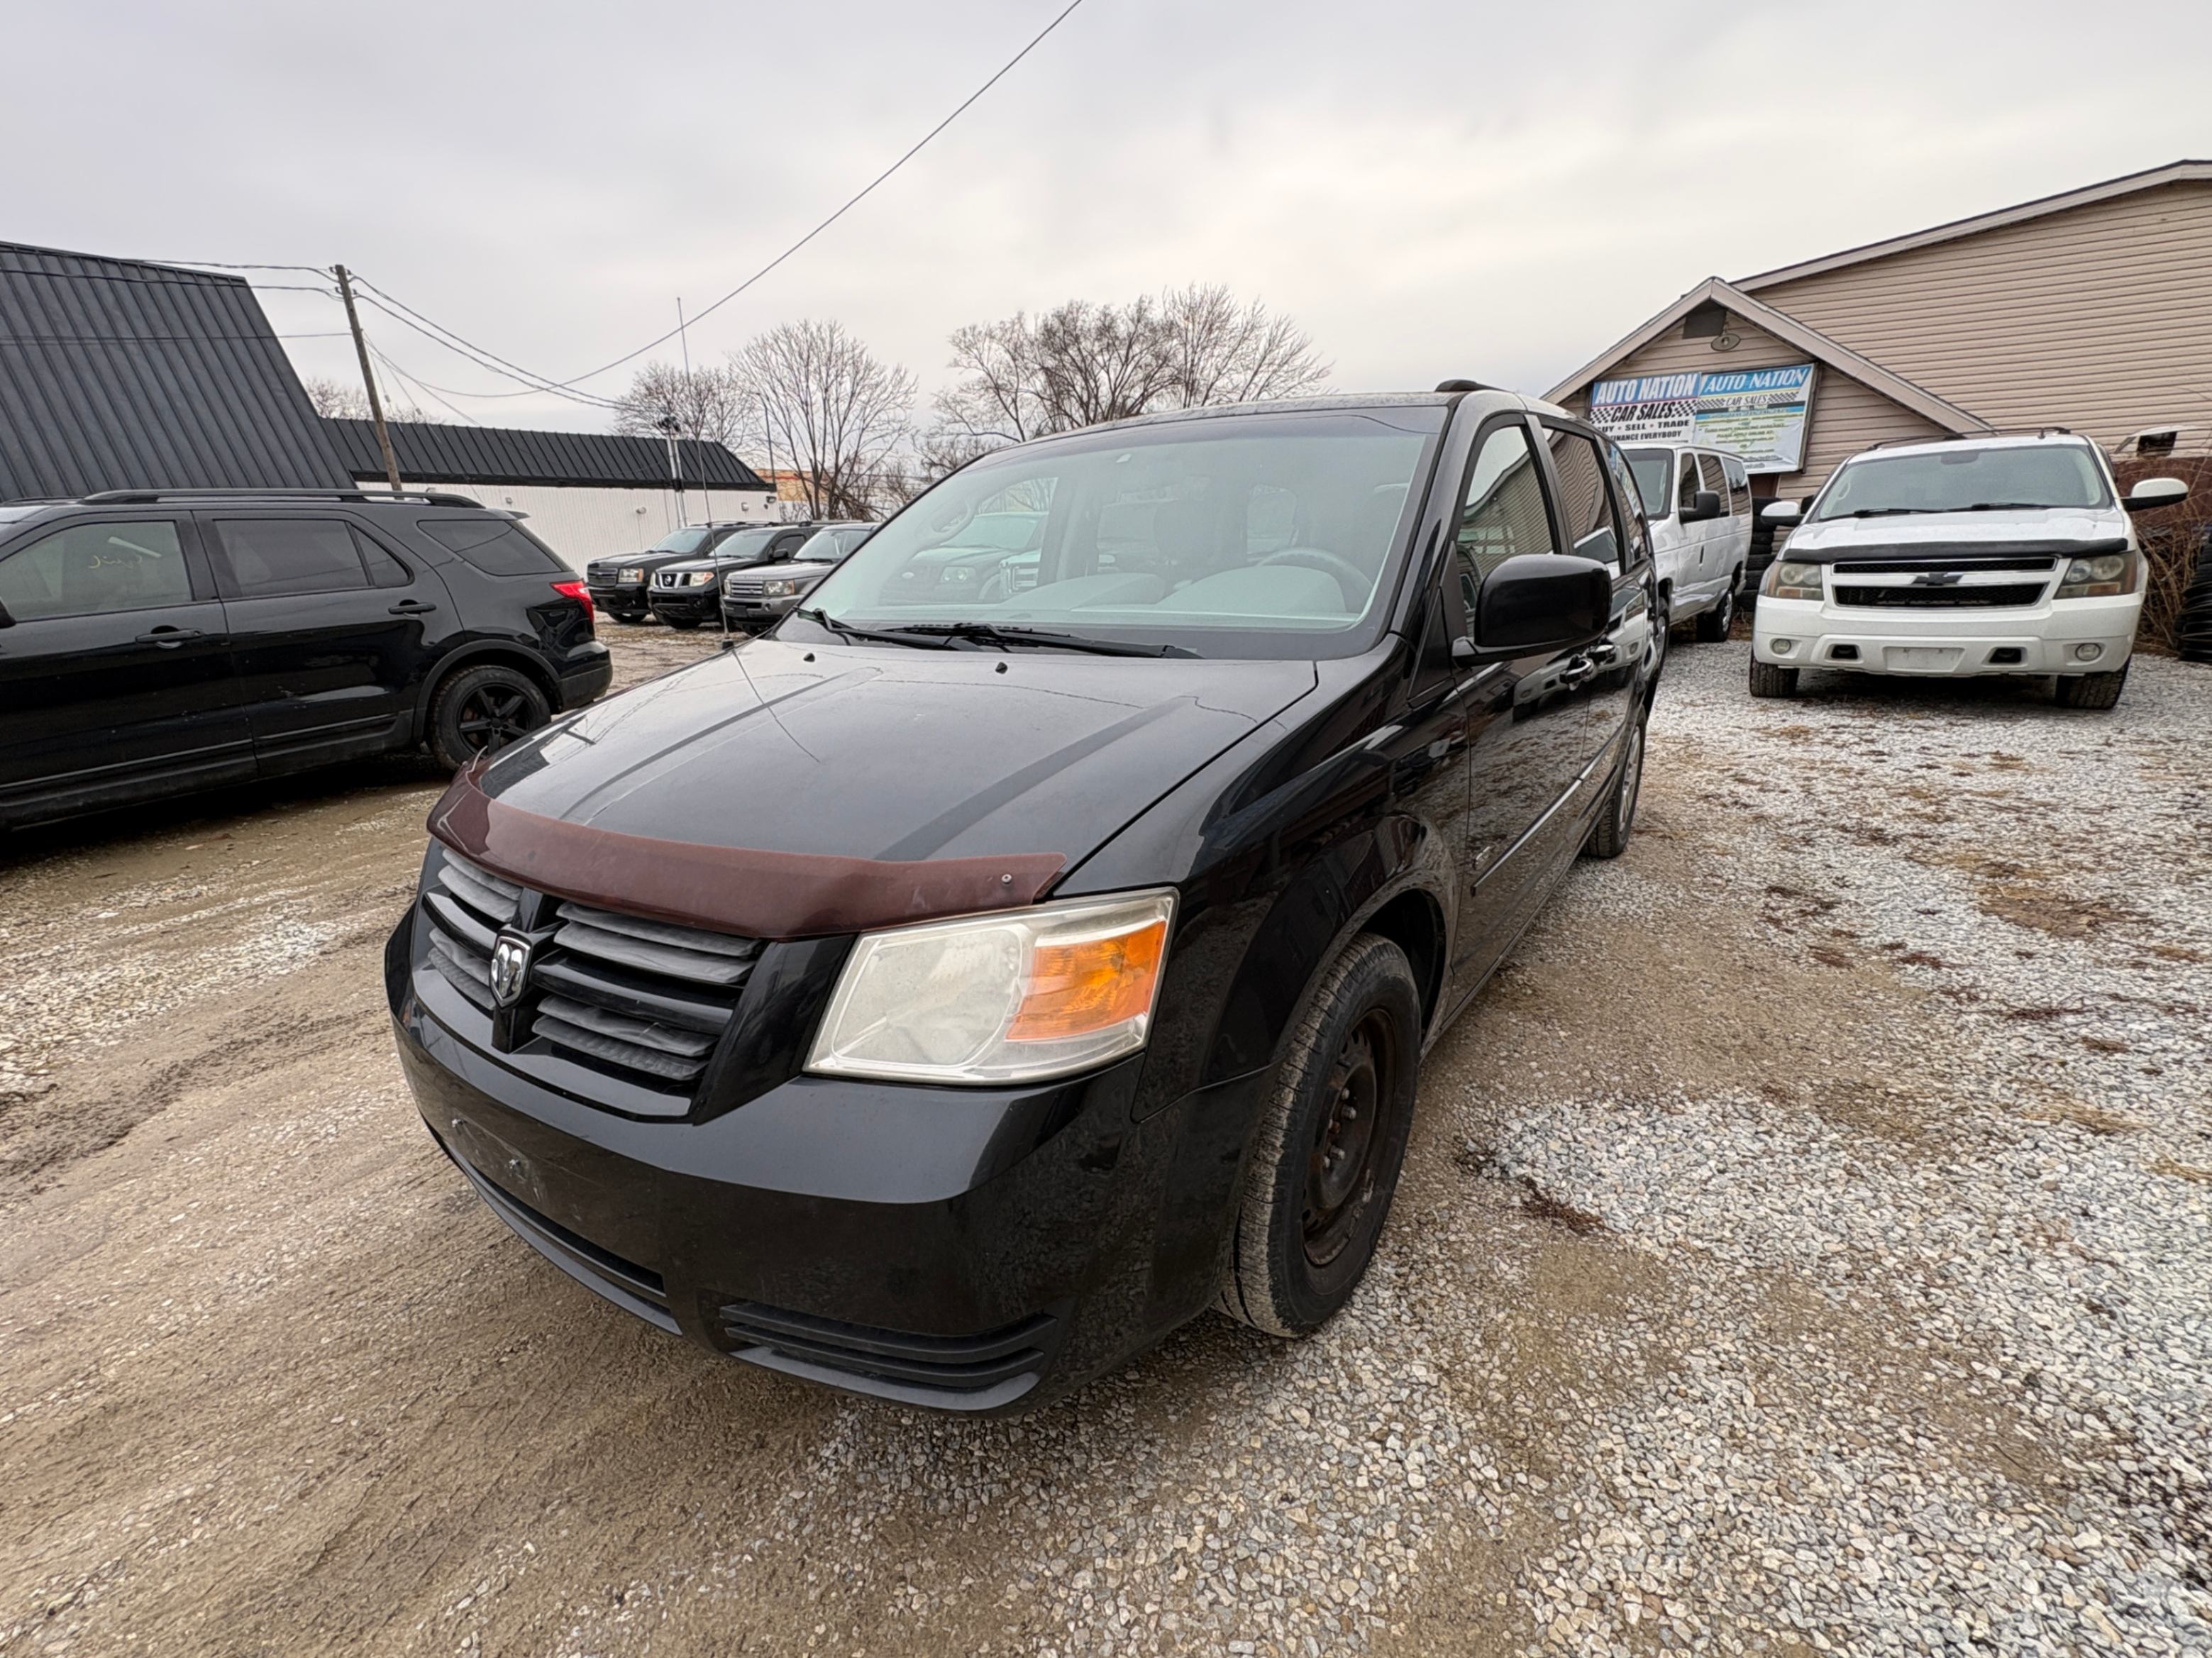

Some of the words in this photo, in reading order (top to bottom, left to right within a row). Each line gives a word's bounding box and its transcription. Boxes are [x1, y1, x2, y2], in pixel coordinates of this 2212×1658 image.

[1595, 380, 1638, 404] AUTO
[1637, 373, 1698, 400] NATION
[1704, 374, 1747, 393] AUTO
[1749, 368, 1808, 389] NATION
[1725, 397, 1741, 407] CAR
[1744, 394, 1768, 405] SALES
[1610, 406, 1637, 423] CAR
[1636, 402, 1676, 421] SALES
[1625, 423, 1646, 431] SELL
[1657, 419, 1690, 429] TRADE
[1640, 431, 1682, 440] EVERYBODY
